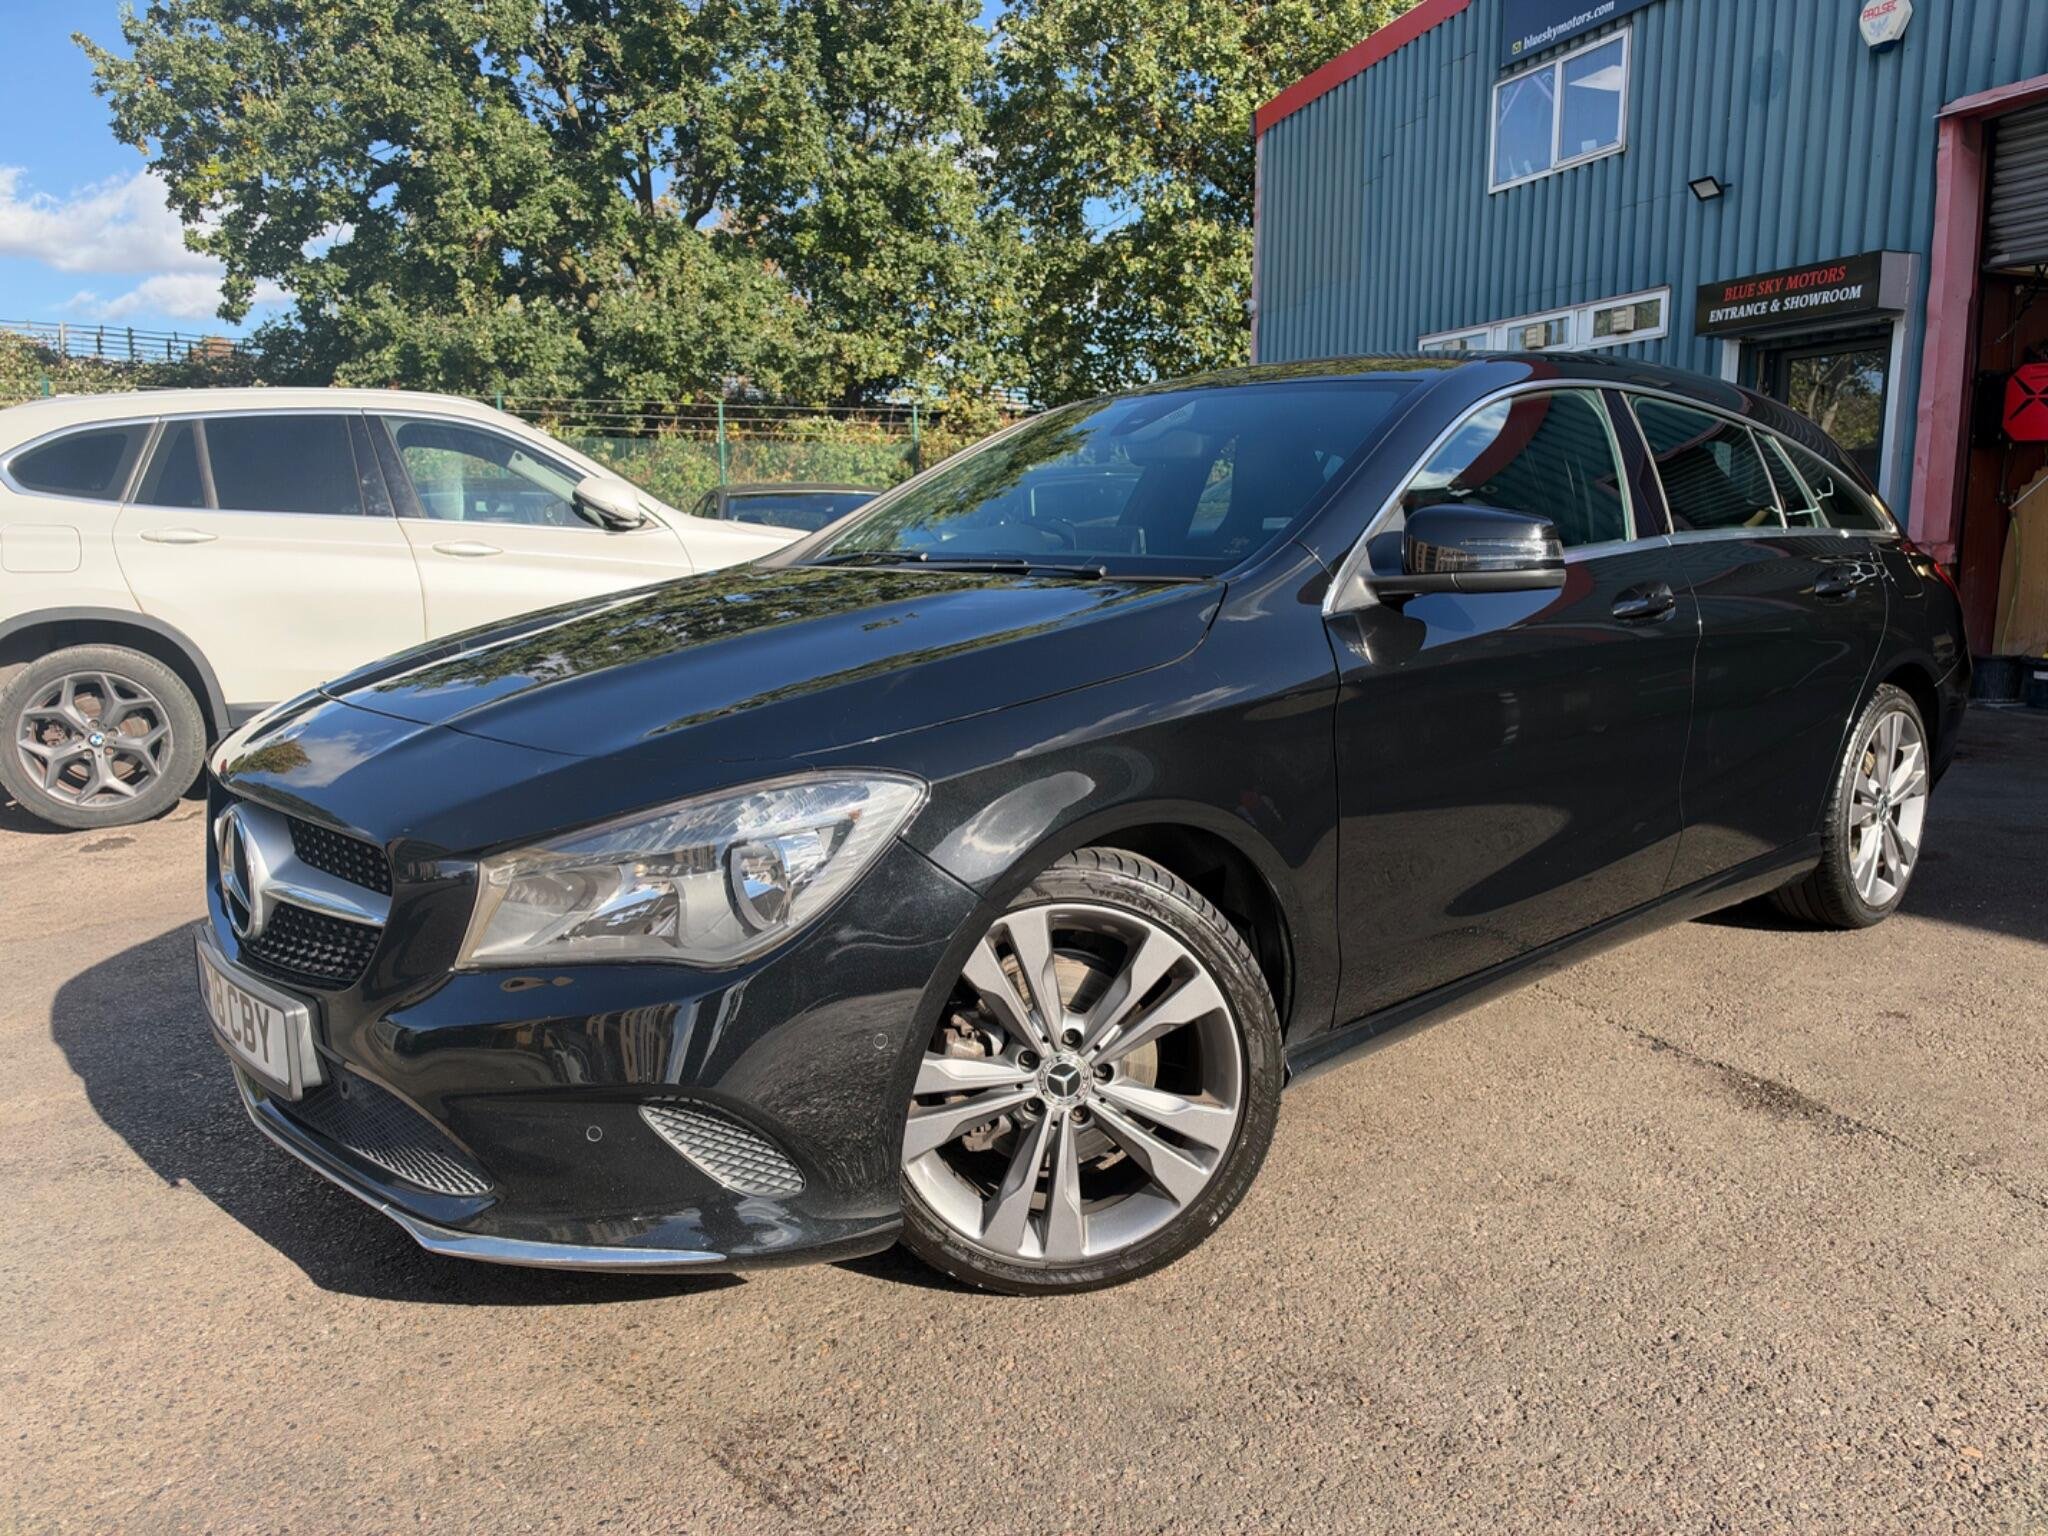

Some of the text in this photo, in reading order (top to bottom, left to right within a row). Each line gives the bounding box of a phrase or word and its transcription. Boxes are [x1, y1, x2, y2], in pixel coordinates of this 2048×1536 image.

[1523, 1, 1615, 49] blueskymotors.com
[1708, 284, 1863, 323] ENTRANCE & SHOWROOM
[1724, 264, 1847, 302] BLUE SKY MOTORS
[227, 984, 269, 1064] CBY
